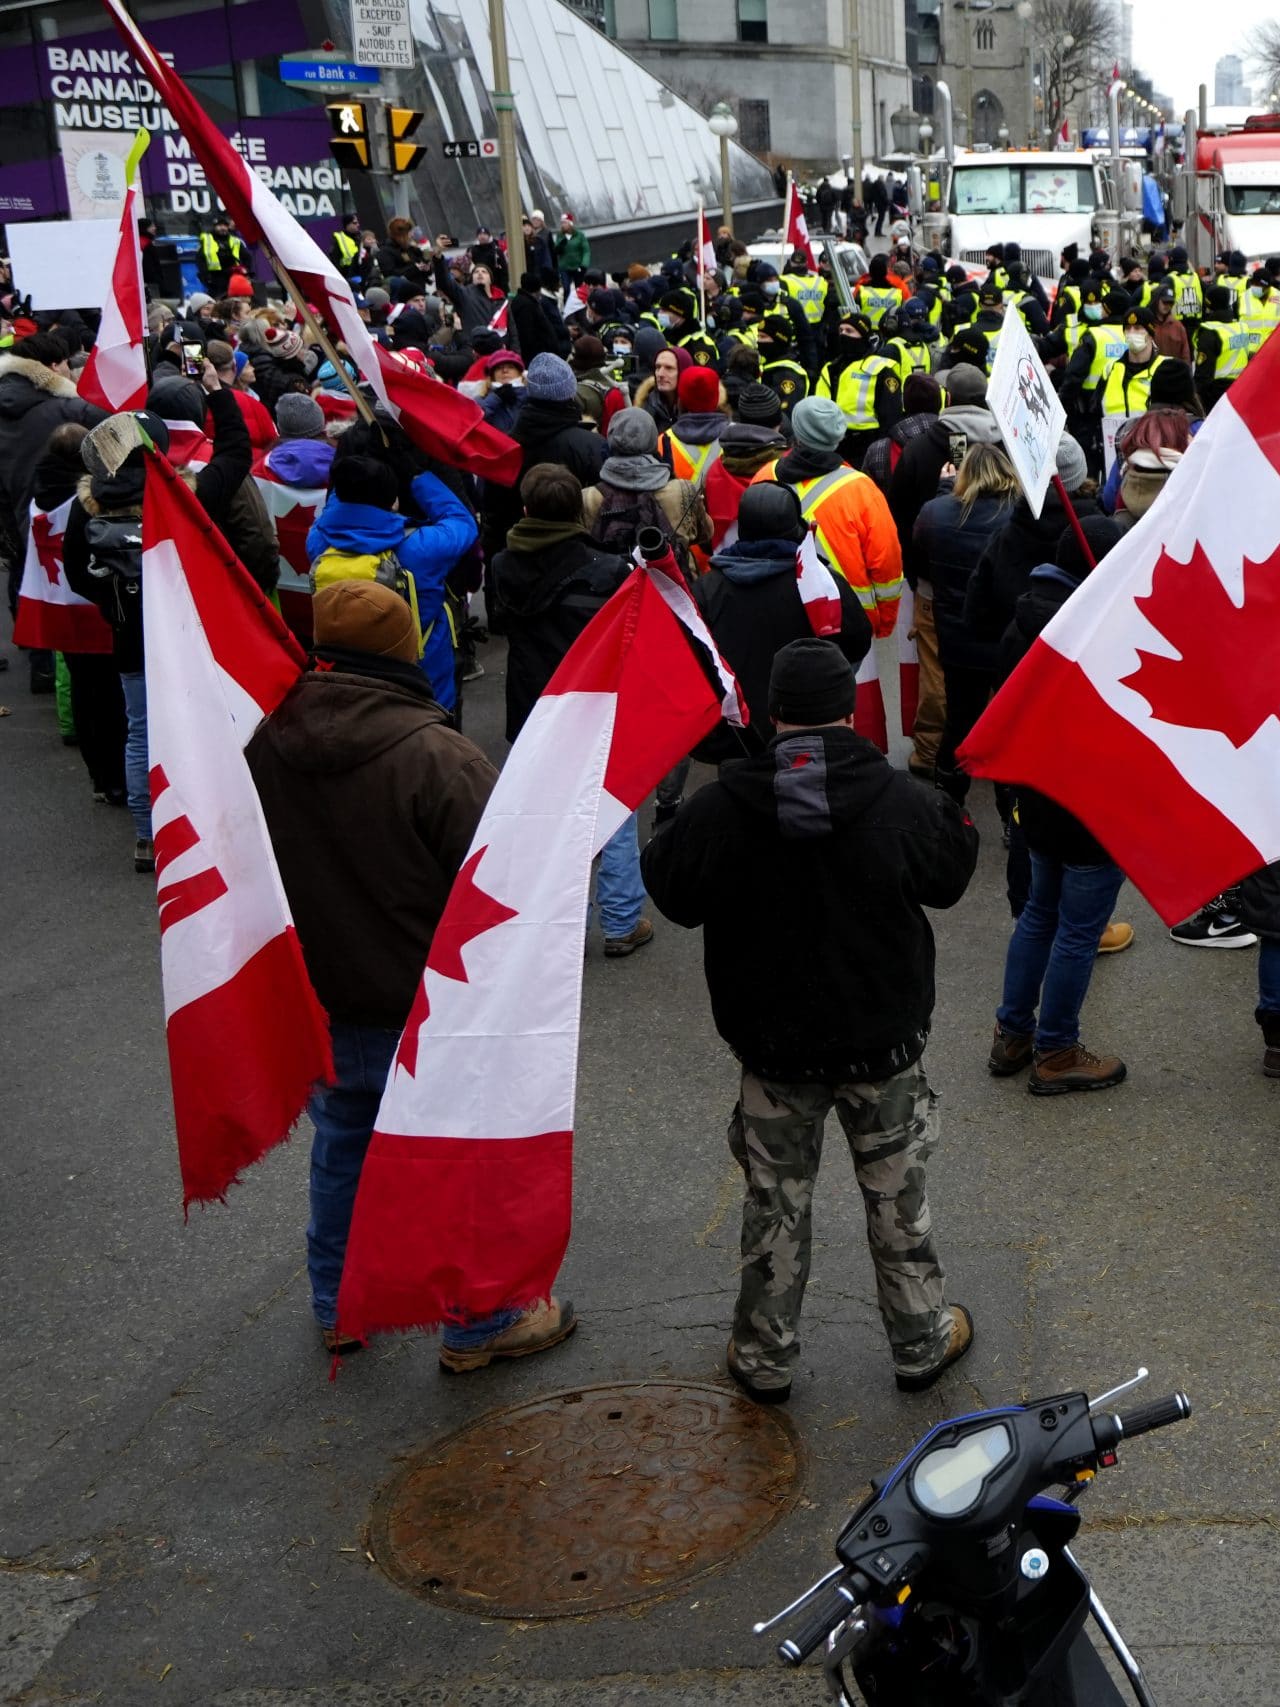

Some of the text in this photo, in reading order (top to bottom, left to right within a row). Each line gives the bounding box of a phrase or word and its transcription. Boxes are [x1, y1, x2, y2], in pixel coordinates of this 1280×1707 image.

[360, 9, 401, 21] EXCEPTED
[372, 26, 391, 37] SAUF
[359, 39, 407, 50] AUTOBUS ET
[48, 47, 131, 74] BANK
[358, 51, 410, 64] BICYCLETTES
[304, 71, 317, 79] rue
[318, 65, 345, 80] Bank
[51, 75, 162, 103] CANAD
[167, 163, 207, 186] DE
[171, 189, 211, 214] DU
